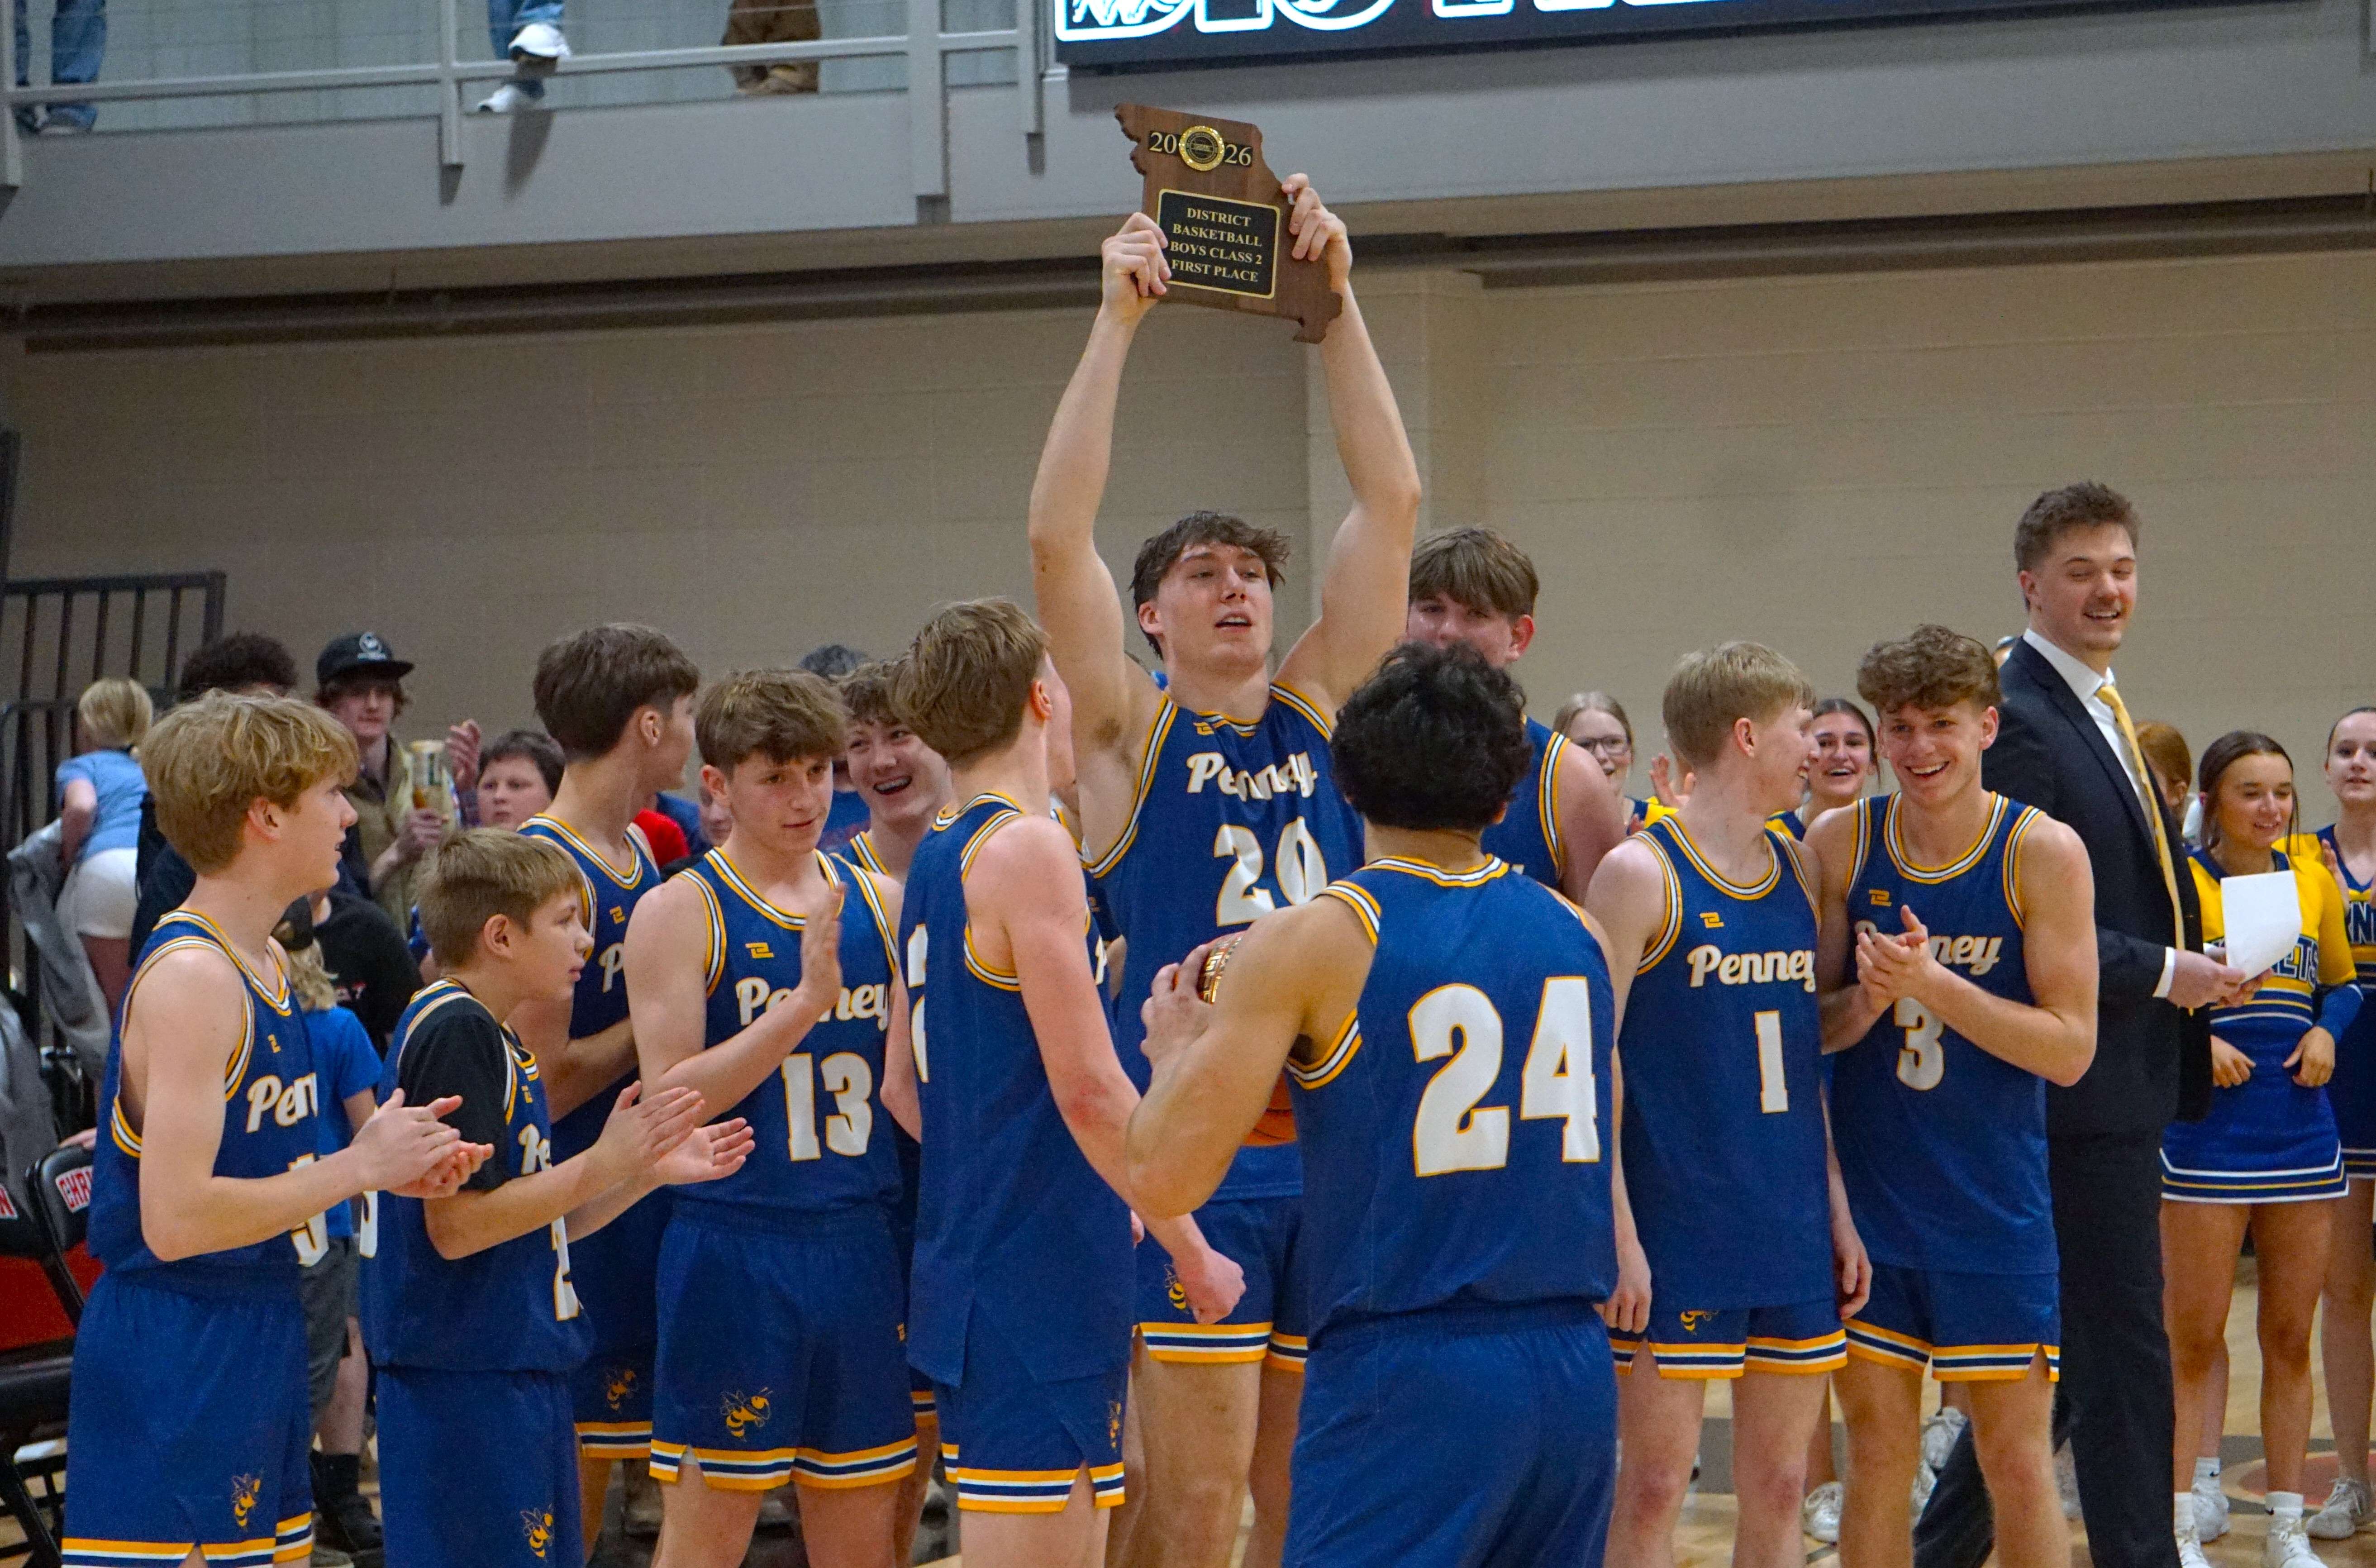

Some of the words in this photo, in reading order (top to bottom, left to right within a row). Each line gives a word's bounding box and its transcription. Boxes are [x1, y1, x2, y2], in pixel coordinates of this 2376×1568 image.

[1149, 132, 1177, 154] 20
[1224, 144, 1252, 166] 26
[1173, 224, 1262, 247] BASKETBALL
[1187, 208, 1251, 227] DISTRICT
[1170, 241, 1207, 256] BOYS
[1209, 247, 1253, 263] CLASS
[1255, 254, 1262, 265] 2
[1171, 259, 1211, 275] FIRST
[1214, 266, 1258, 282] PLACE
[1214, 816, 1328, 927] 20
[1856, 920, 2000, 976] Pney
[735, 977, 889, 1032] Pney
[1754, 1010, 1789, 1114] 1
[1894, 996, 1945, 1091] 3
[1407, 975, 1600, 1177] 24
[781, 1052, 872, 1161] 13
